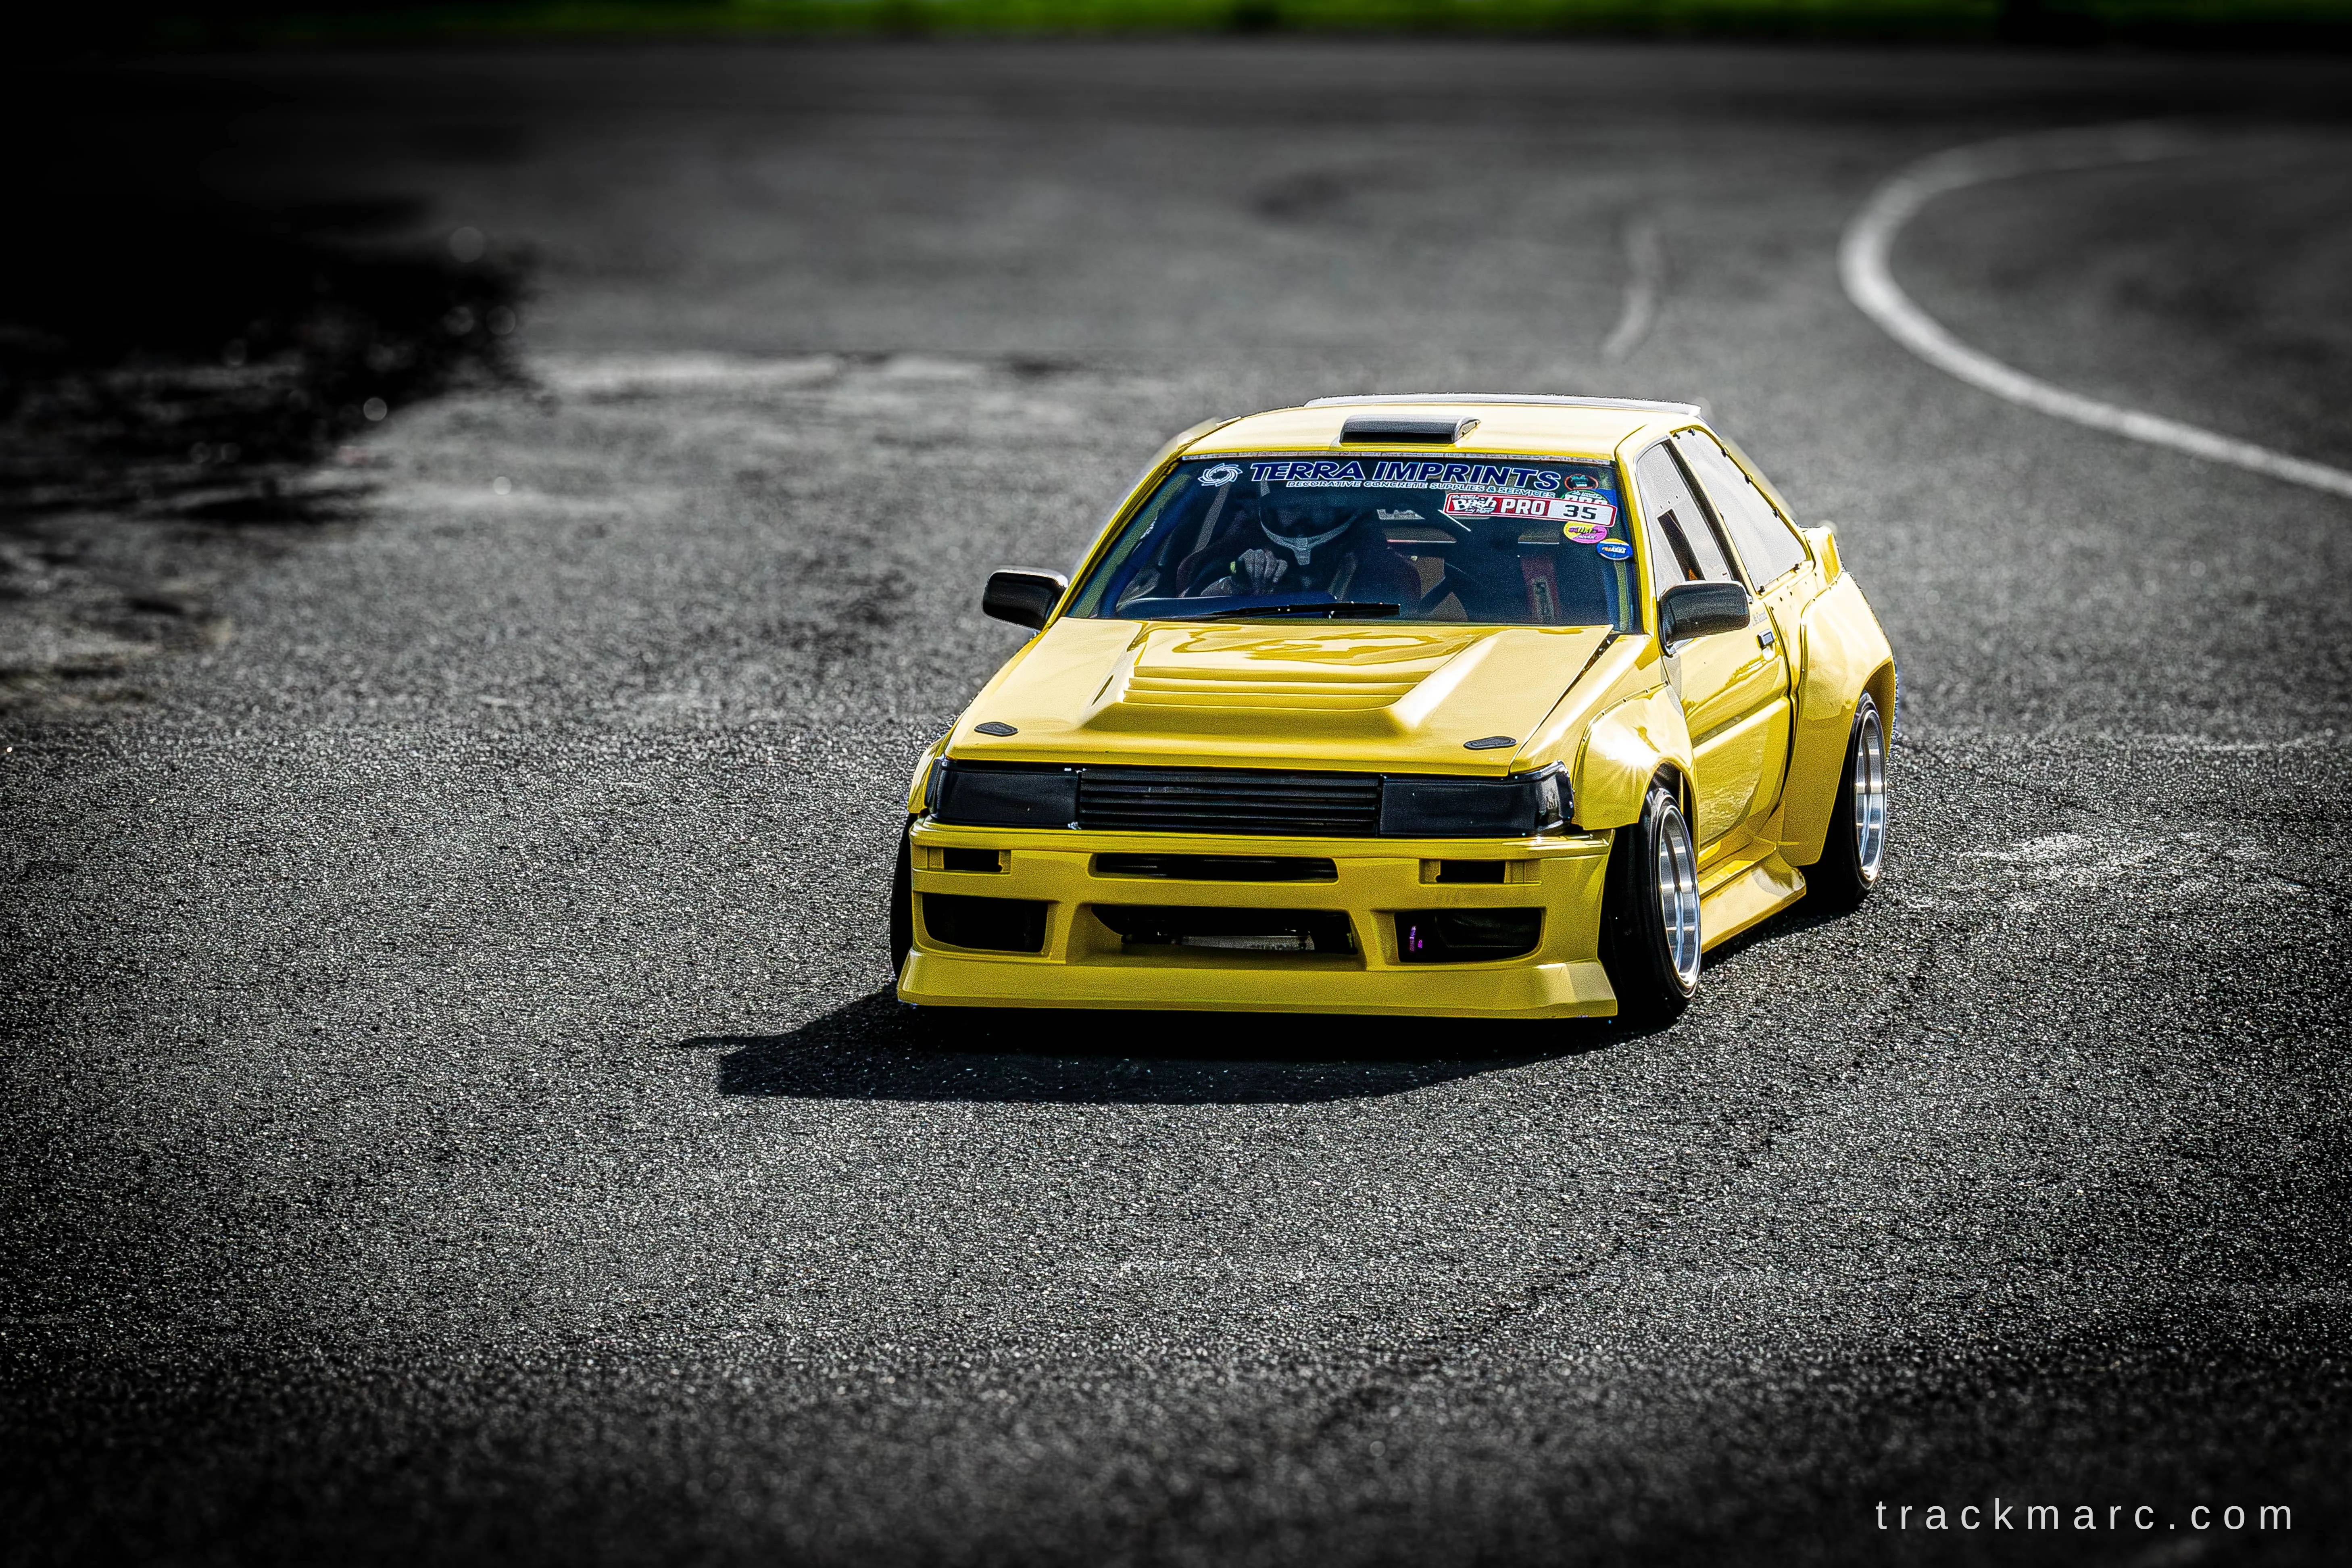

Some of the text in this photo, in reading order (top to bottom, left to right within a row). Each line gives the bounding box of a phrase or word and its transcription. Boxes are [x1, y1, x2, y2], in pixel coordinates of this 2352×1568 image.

[1250, 461, 1366, 482] TERRA
[1372, 461, 1561, 491] IMPRINTS
[1363, 481, 1428, 489] CONCRETE
[1430, 482, 1485, 492] SUPPLIES
[1486, 485, 1496, 493] &
[1497, 486, 1556, 498] SERVICES
[1500, 498, 1546, 515] PRO
[1563, 505, 1597, 520] 35
